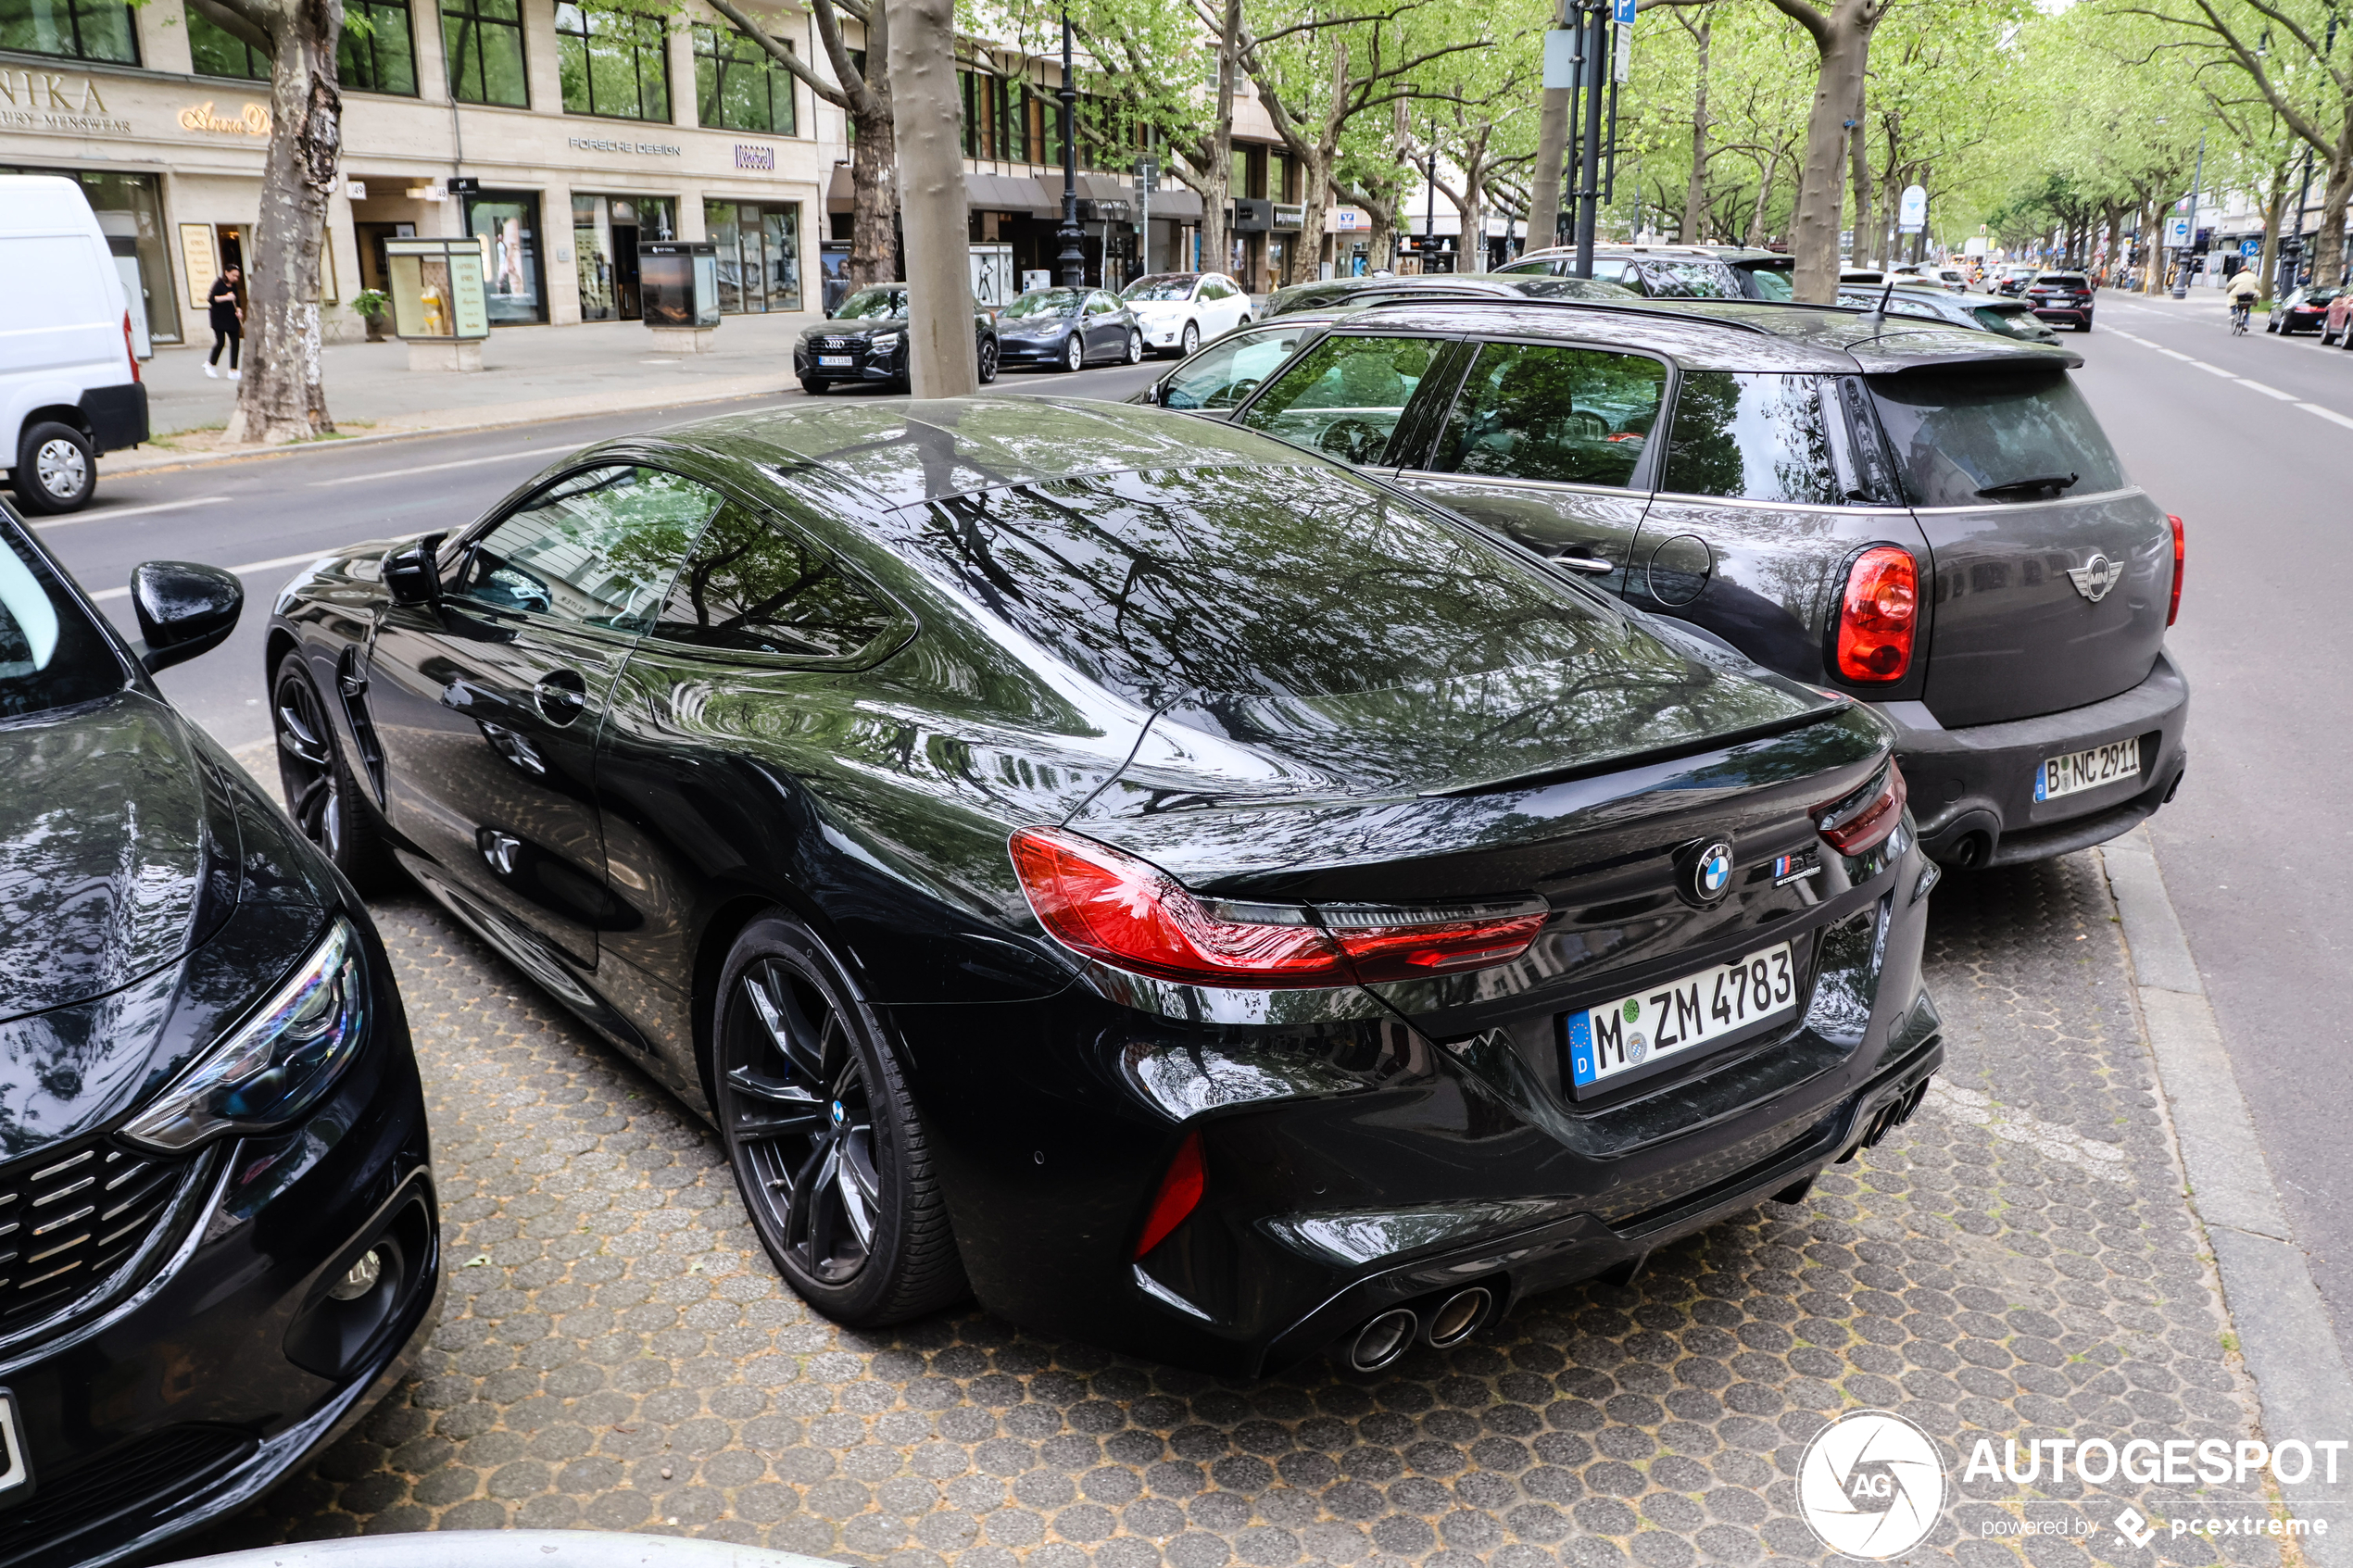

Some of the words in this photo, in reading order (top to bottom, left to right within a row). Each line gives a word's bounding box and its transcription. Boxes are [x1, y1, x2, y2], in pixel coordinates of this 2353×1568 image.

[43, 114, 131, 132] MENSWEAR
[182, 102, 245, 132] Anna
[569, 137, 633, 153] PORSCHE
[635, 143, 682, 156] DESIGN
[741, 150, 768, 164] Wolford
[354, 185, 363, 194] 49
[437, 187, 447, 197] 48
[2090, 571, 2108, 585] MINI
[2047, 759, 2060, 793] B
[2073, 750, 2096, 786] NC
[2100, 739, 2138, 780] 2911
[2038, 784, 2044, 794] D
[1784, 866, 1821, 884] competition
[1594, 1009, 1625, 1069] M
[1649, 983, 1704, 1049] ZM
[1712, 949, 1792, 1025] 4783
[1578, 1057, 1588, 1074] D
